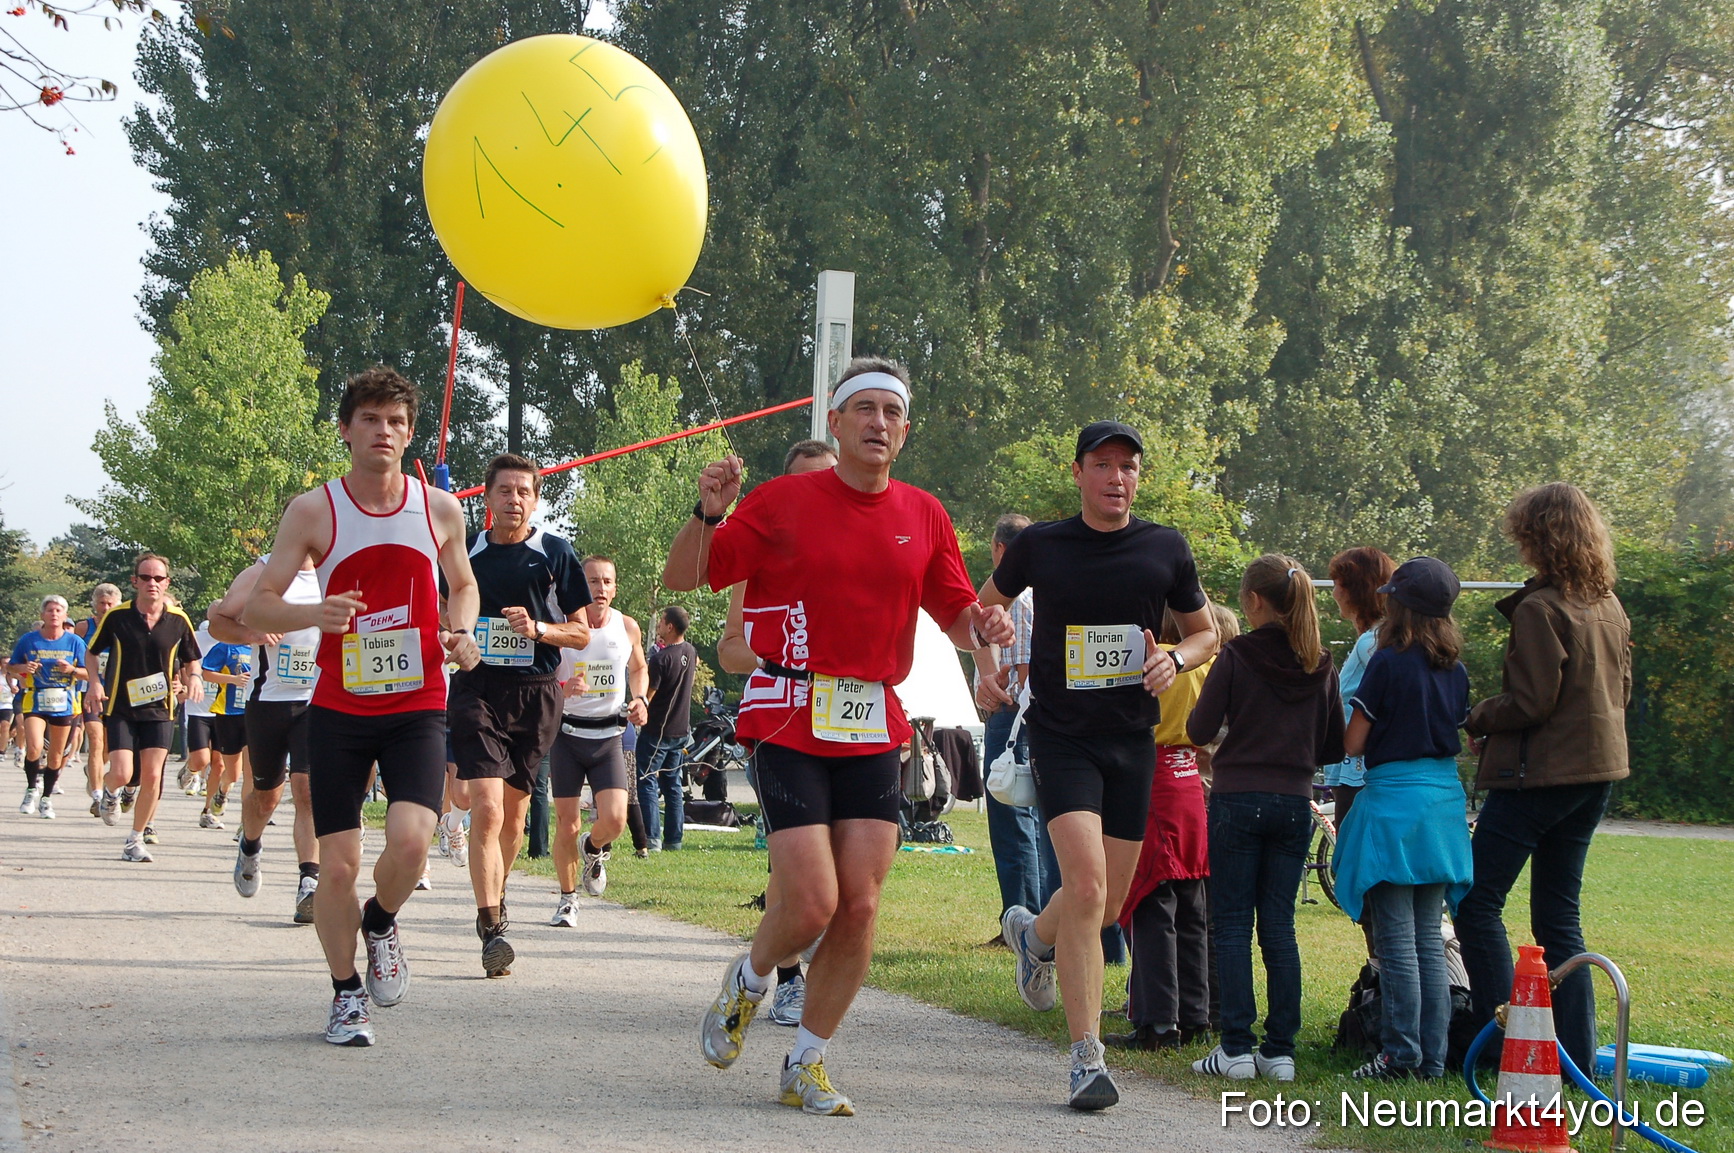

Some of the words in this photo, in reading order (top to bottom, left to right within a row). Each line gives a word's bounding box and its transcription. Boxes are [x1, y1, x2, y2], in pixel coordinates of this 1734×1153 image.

[370, 613, 395, 627] DEHN
[789, 600, 810, 660] BÖGL
[362, 637, 395, 650] Tobias
[491, 635, 528, 649] 2905
[1087, 630, 1124, 644] Florian
[293, 649, 311, 658] Josef
[1069, 649, 1075, 659] B
[1095, 649, 1133, 668] 937
[292, 660, 316, 672] 357
[346, 657, 351, 667] A
[371, 653, 410, 674] 316
[588, 664, 613, 672] Andreas
[593, 674, 615, 686] 760
[837, 678, 864, 694] Peter
[139, 680, 164, 695] 1095
[46, 696, 64, 704] 3906
[815, 696, 822, 708] B
[840, 700, 874, 721] 207
